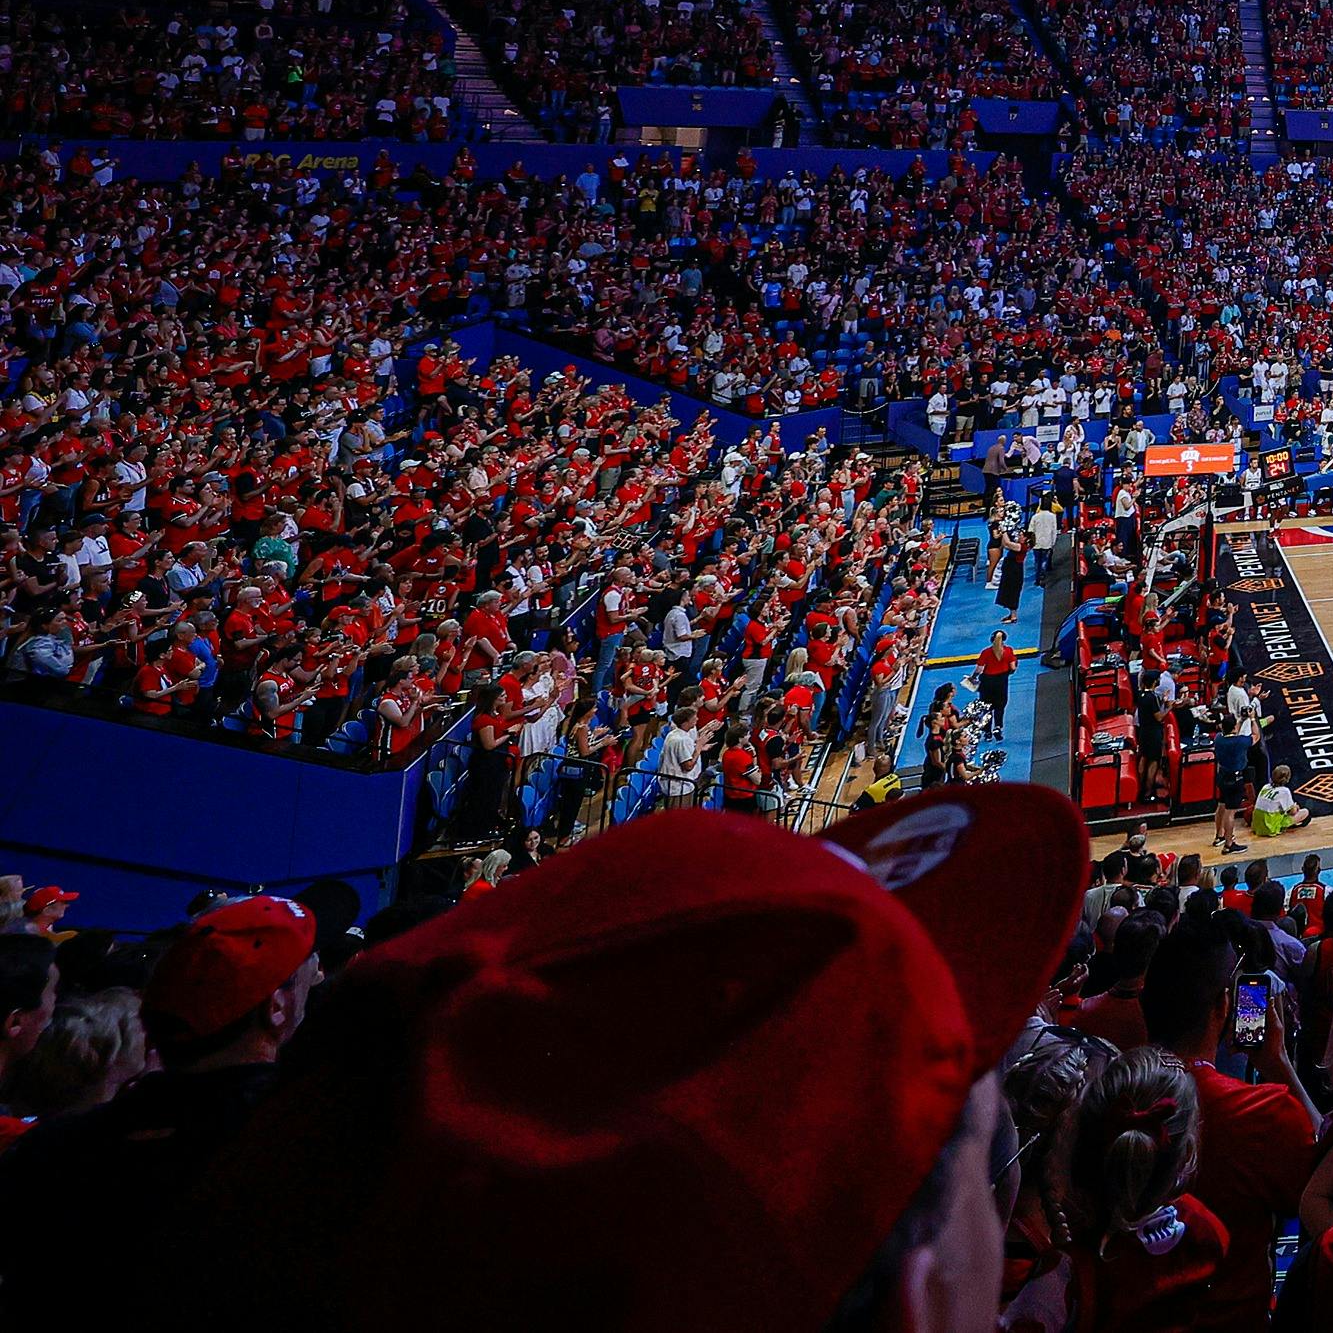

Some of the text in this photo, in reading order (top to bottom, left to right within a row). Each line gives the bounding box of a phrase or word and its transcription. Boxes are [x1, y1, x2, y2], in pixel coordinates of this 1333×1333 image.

[297, 153, 359, 169] Arena
[1265, 451, 1289, 464] 10:00
[1268, 463, 1286, 477] 24
[427, 599, 446, 613] 10
[1251, 602, 1300, 661] PENTANET
